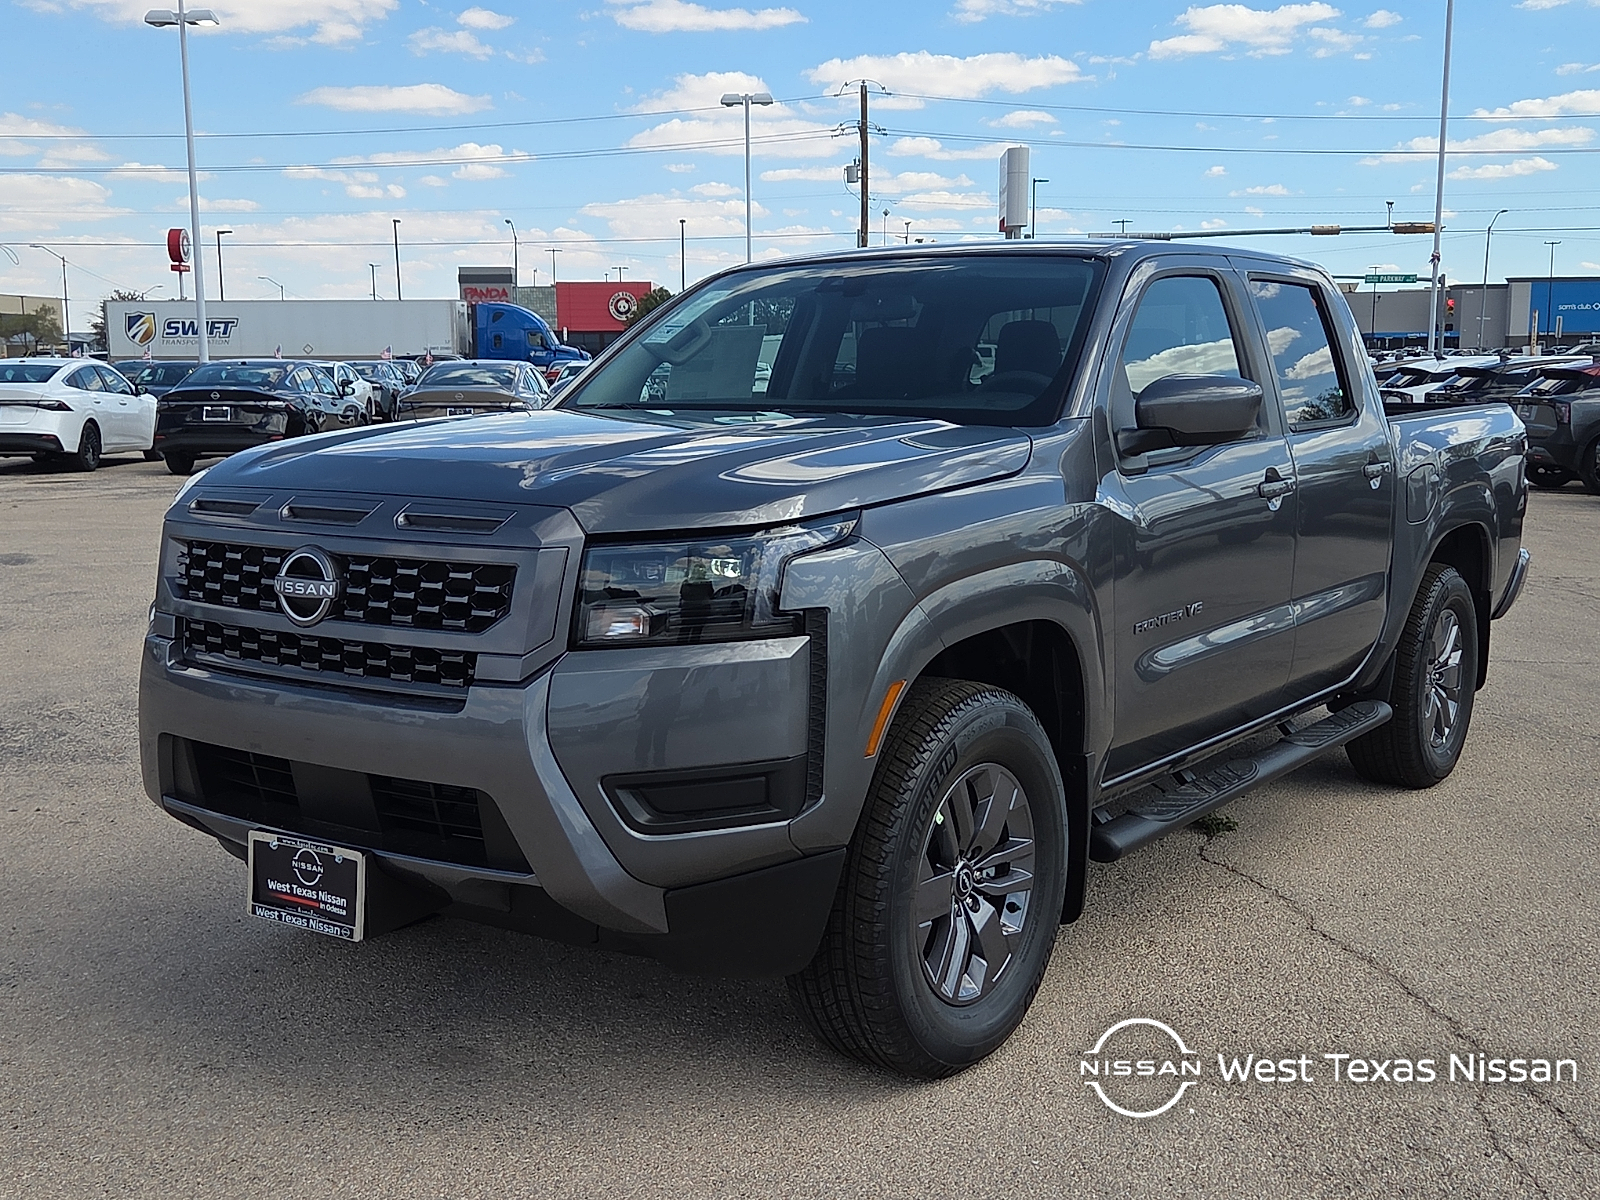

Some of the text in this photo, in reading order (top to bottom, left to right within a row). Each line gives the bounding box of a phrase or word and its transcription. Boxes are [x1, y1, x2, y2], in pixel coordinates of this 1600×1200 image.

[463, 287, 508, 299] PANDA
[275, 579, 333, 596] NISSAN
[1133, 601, 1203, 635] FRONTIER V6
[909, 748, 955, 853] MICHELIN
[292, 860, 324, 873] NISSAN
[267, 879, 347, 907] West Texas Nissan
[255, 906, 279, 920] West
[280, 912, 307, 926] Texas
[309, 919, 340, 935] Nissan
[325, 904, 347, 916] Odessa
